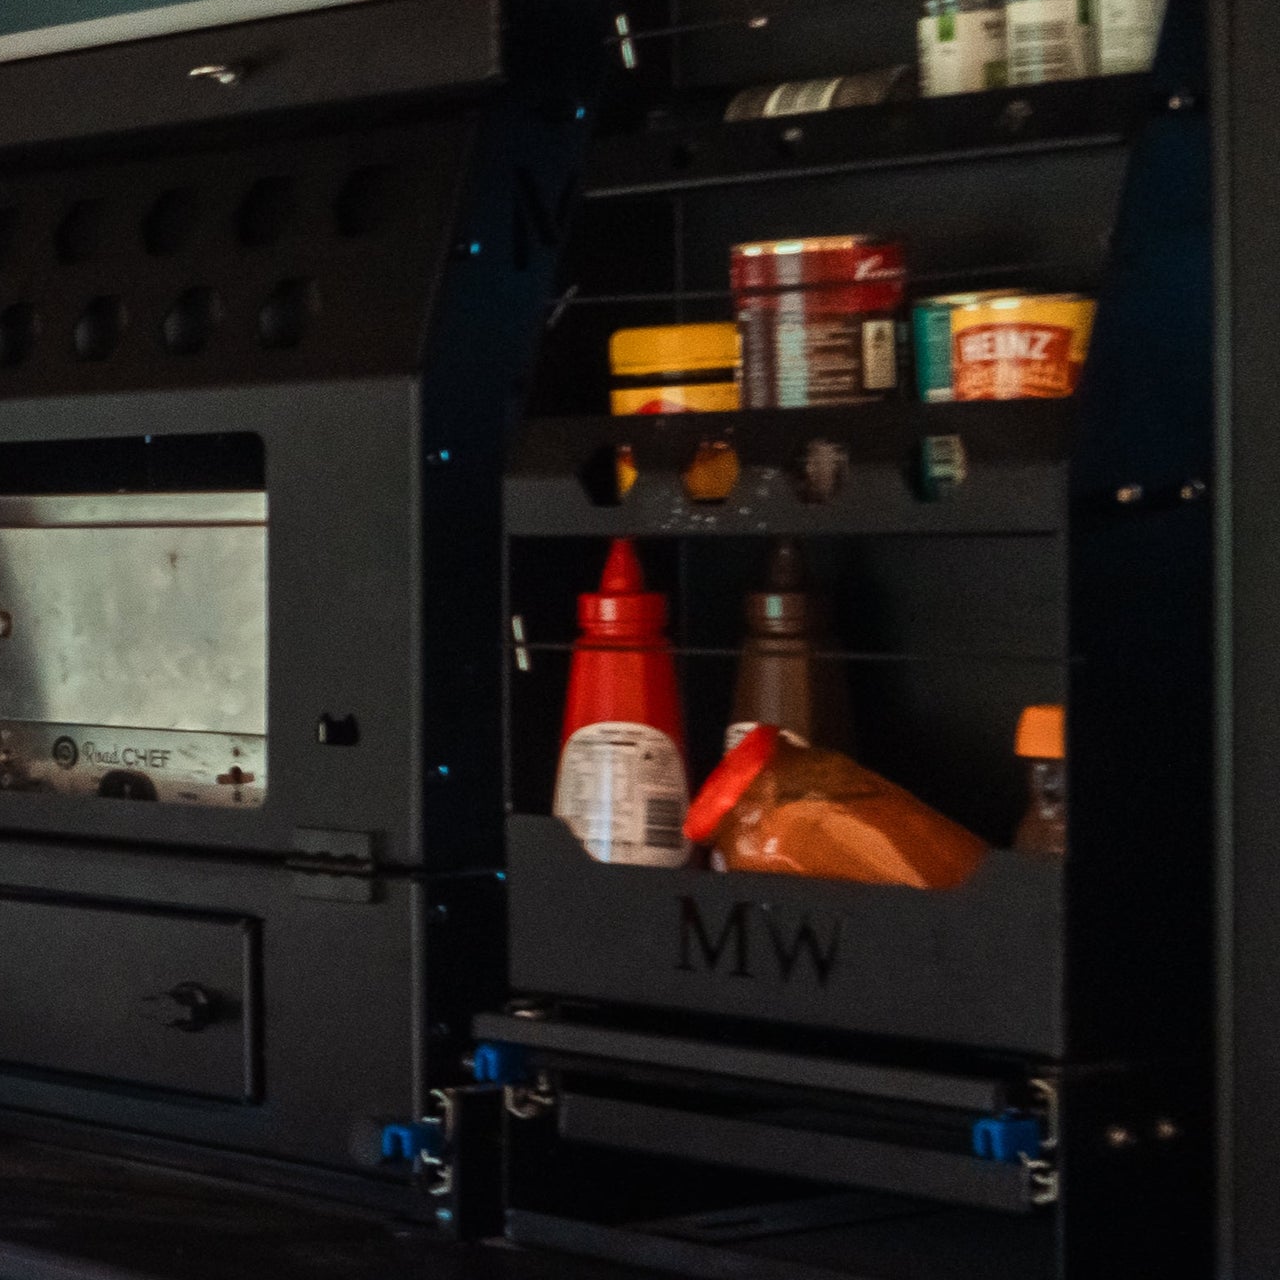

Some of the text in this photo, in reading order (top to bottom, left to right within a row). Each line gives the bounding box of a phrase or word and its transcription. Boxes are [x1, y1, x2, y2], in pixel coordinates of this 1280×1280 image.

[958, 329, 1054, 362] HEINZ
[82, 741, 171, 768] Road CHEF
[676, 895, 840, 985] MW
